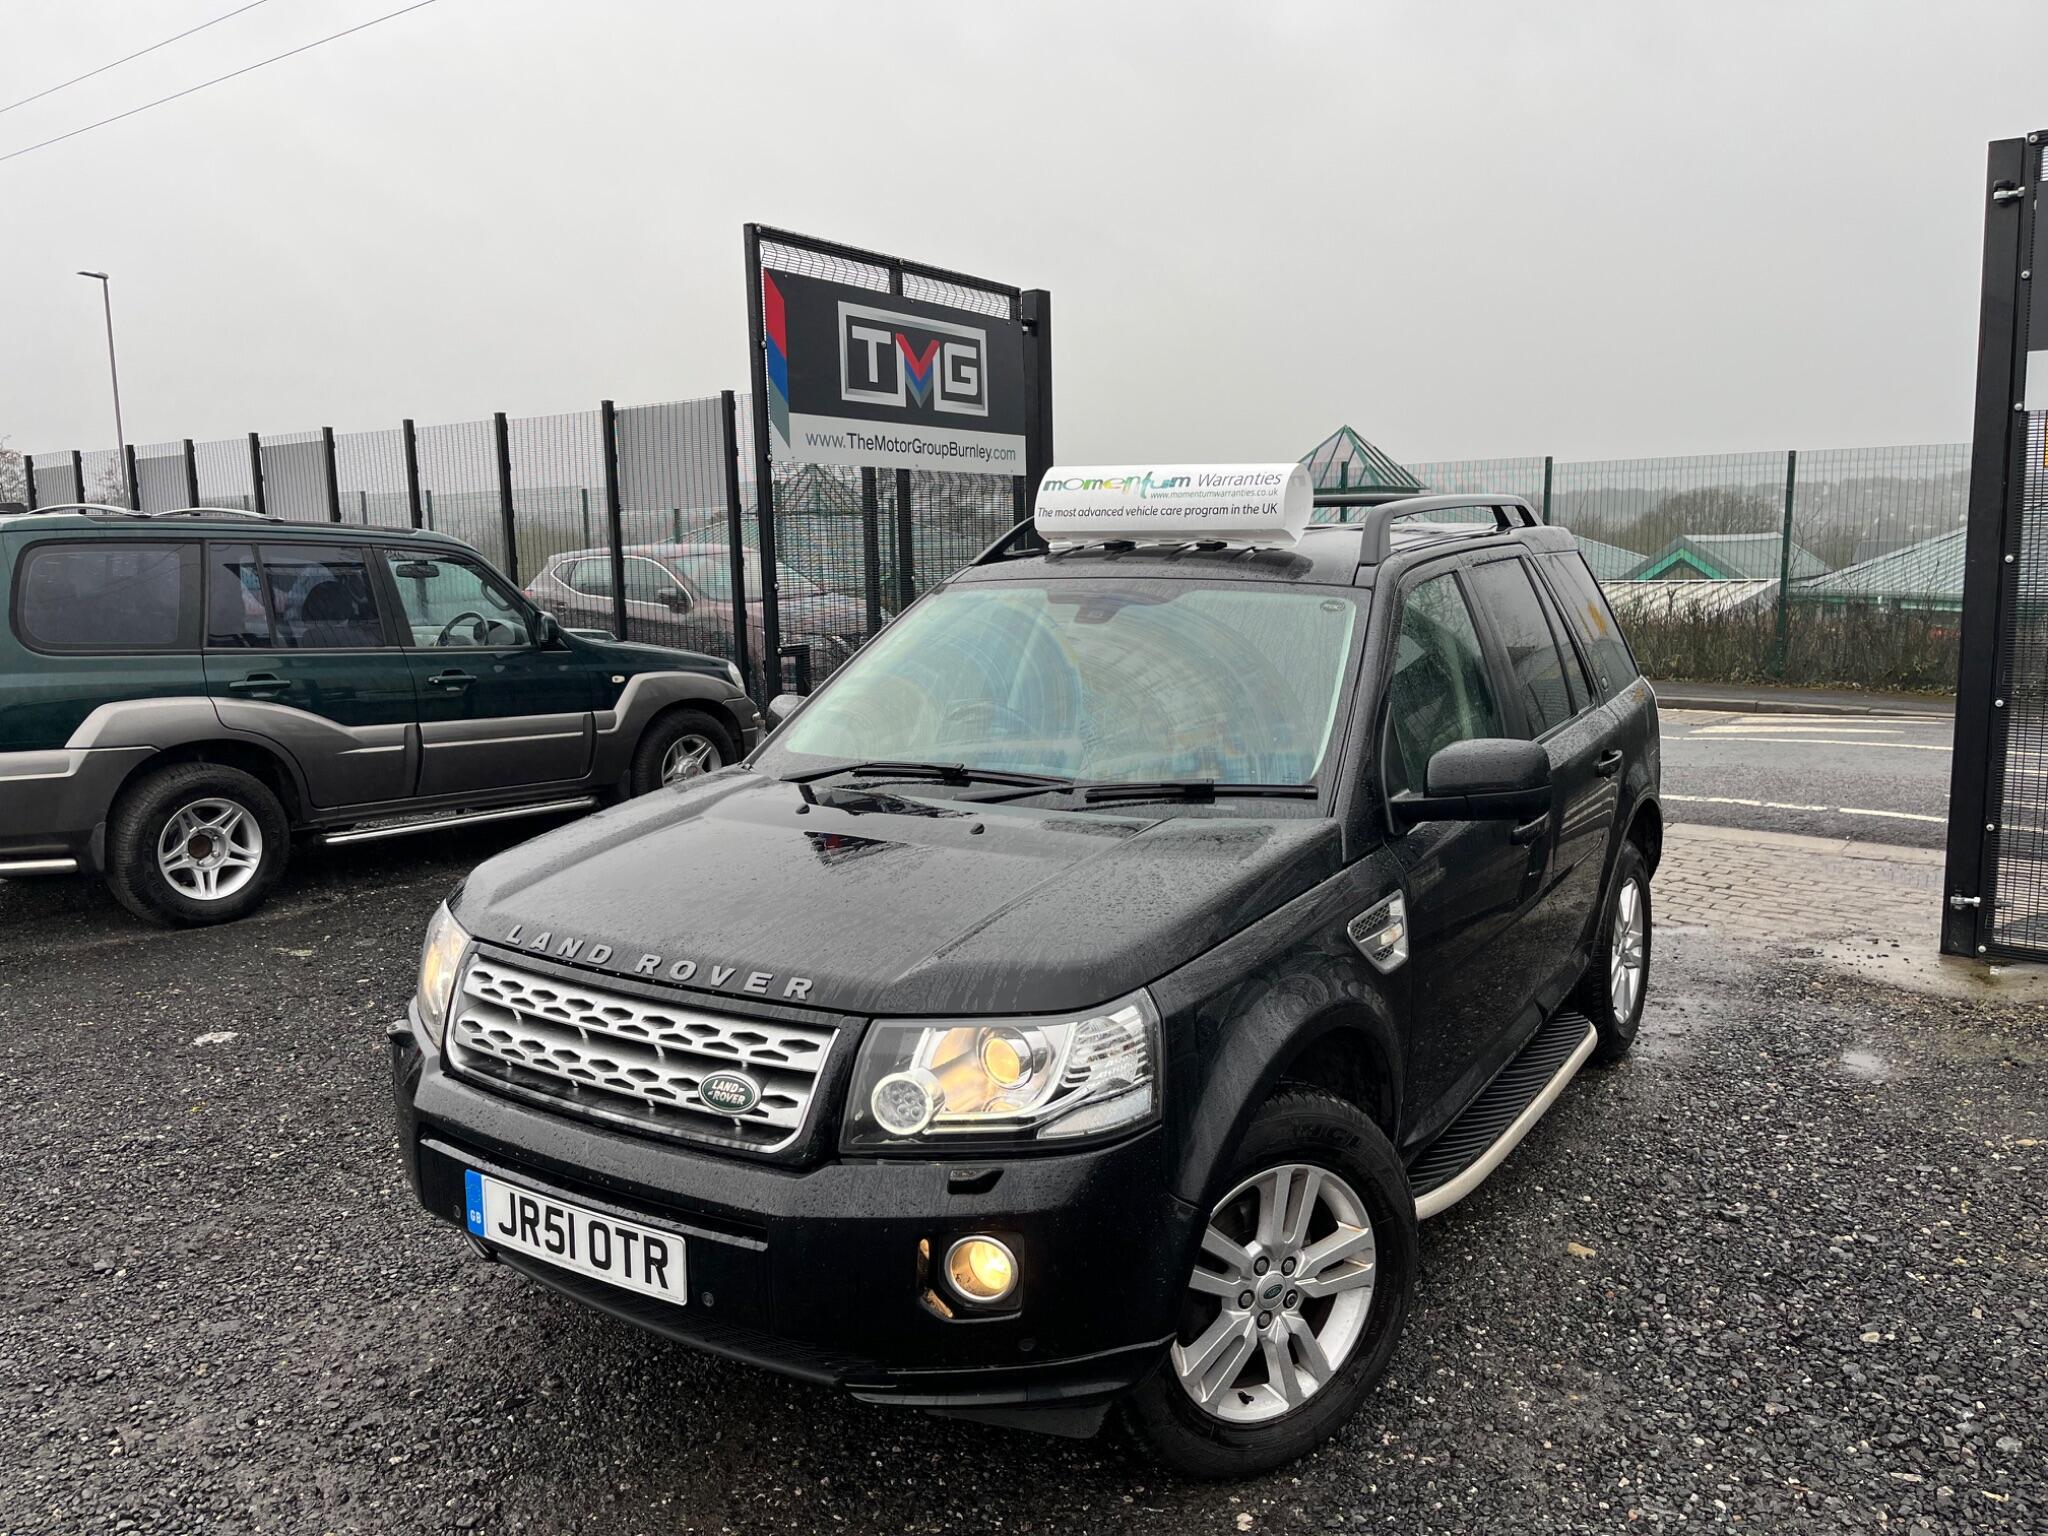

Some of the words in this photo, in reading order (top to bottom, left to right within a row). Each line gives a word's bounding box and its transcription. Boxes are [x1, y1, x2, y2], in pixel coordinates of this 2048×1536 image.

[851, 325, 978, 409] TMG
[805, 432, 1016, 461] www.TheMotorGroupBurnley.com
[1043, 471, 1191, 499] momentum
[1198, 473, 1281, 487] Warranties
[1150, 488, 1279, 499] www.momentumwarranties.co.uk
[1039, 507, 1053, 518] The
[1055, 507, 1077, 517] most
[1078, 506, 1125, 517] advanced
[1126, 505, 1158, 516] vehicle
[1160, 506, 1181, 516] care
[1184, 505, 1229, 518] program
[1230, 504, 1240, 515] in
[1242, 504, 1260, 515] the
[1262, 502, 1278, 514] UK
[505, 924, 614, 965] LAND
[634, 953, 815, 1000] ROVER
[711, 1079, 739, 1093] LAND
[712, 1090, 746, 1105] ROVER
[470, 1209, 482, 1224] GB
[498, 1192, 576, 1260] JR51
[588, 1220, 669, 1290] OTR
